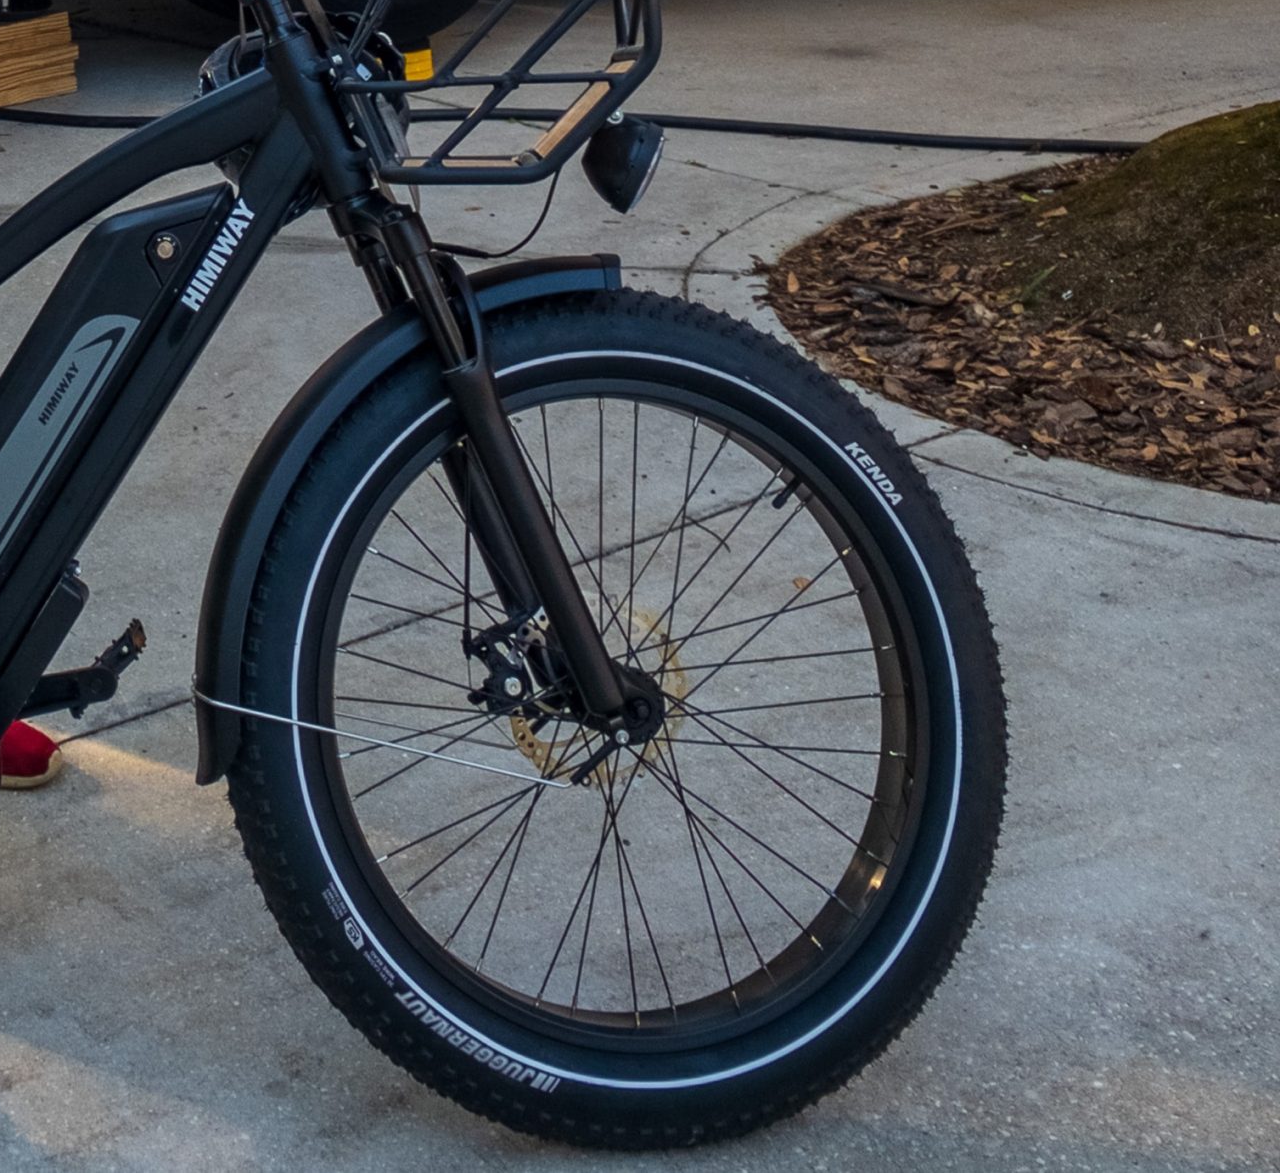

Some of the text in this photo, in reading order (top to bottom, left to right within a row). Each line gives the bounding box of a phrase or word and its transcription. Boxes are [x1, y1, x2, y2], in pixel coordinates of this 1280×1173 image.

[181, 197, 256, 312] HIMIWAY
[38, 361, 79, 426] HIMIWAY
[844, 441, 904, 506] KENDA
[346, 927, 360, 943] KS
[394, 990, 537, 1084] JUGGERNAUT
